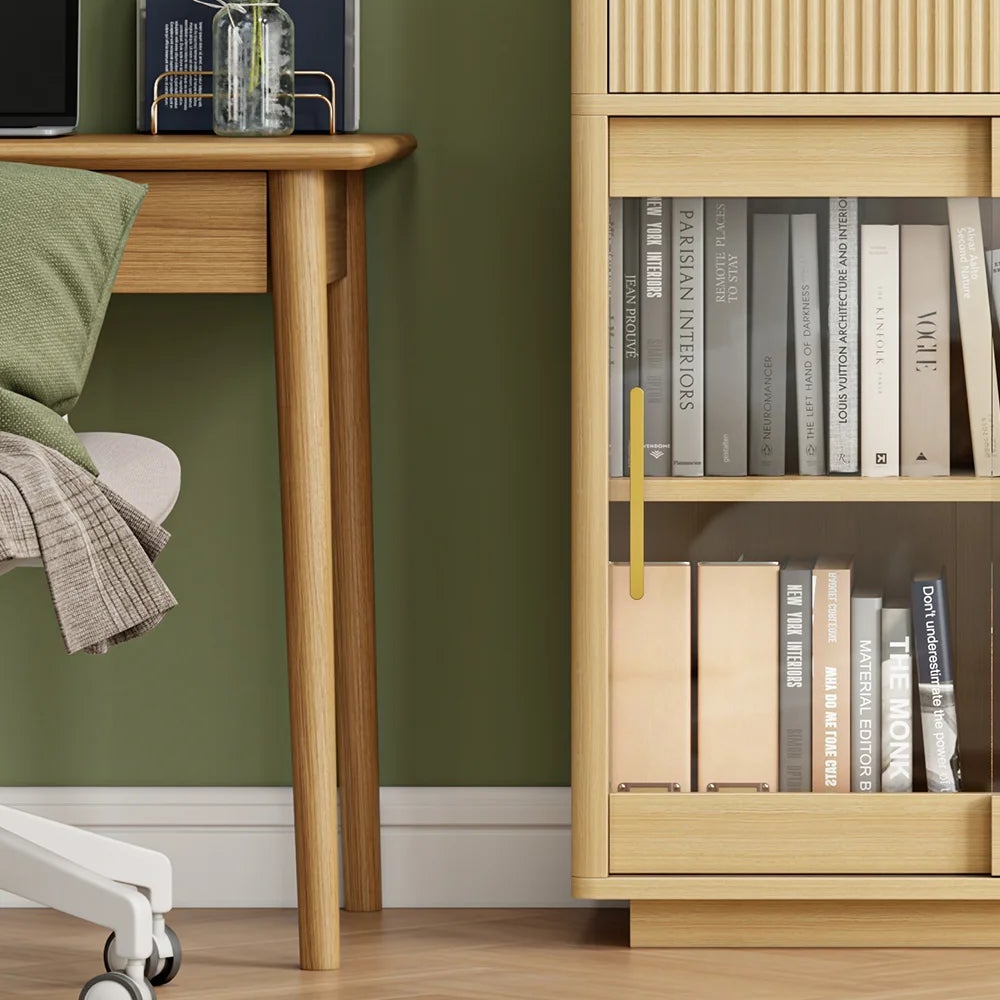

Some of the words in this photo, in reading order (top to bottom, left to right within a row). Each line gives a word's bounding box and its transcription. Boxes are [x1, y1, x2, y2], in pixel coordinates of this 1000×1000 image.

[646, 222, 662, 246] YORK
[716, 203, 725, 247] PLACES
[838, 197, 848, 240] INTERIO
[967, 226, 978, 252] Alvar
[646, 252, 662, 298] INTERIORS
[680, 210, 694, 300] PARISIAN
[728, 252, 738, 282] STAY
[838, 243, 848, 266] AND
[956, 227, 968, 264] Second
[962, 266, 972, 299] Nature
[970, 254, 979, 280] Aalto
[625, 274, 636, 304] JEAN
[716, 252, 726, 303] REMOTE
[728, 286, 738, 303] TO
[802, 284, 811, 336] DARKNESS
[838, 269, 848, 344] ARCHITECTURE
[625, 309, 638, 359] PROUVÉ
[803, 342, 812, 356] OF
[876, 308, 885, 365] KINFOLK
[916, 311, 937, 372] VOGUE
[680, 309, 694, 410] INTERIORS
[804, 360, 814, 391] HAND
[838, 346, 848, 390] VUITTON
[762, 356, 773, 440] NEUROMANCER
[804, 396, 814, 417] LEFT
[838, 393, 848, 424] LOUIS
[806, 421, 815, 440] THE
[786, 584, 802, 606] NEW
[922, 586, 936, 618] Don't
[786, 612, 802, 635] YORK
[786, 642, 802, 688] INTERIORS
[860, 640, 872, 714] MATERIAL
[889, 636, 910, 690] THE
[925, 620, 943, 707] underestimate
[889, 699, 910, 780] MONK
[933, 709, 944, 730] the
[860, 720, 872, 777] EDITOR
[934, 732, 950, 770] power
